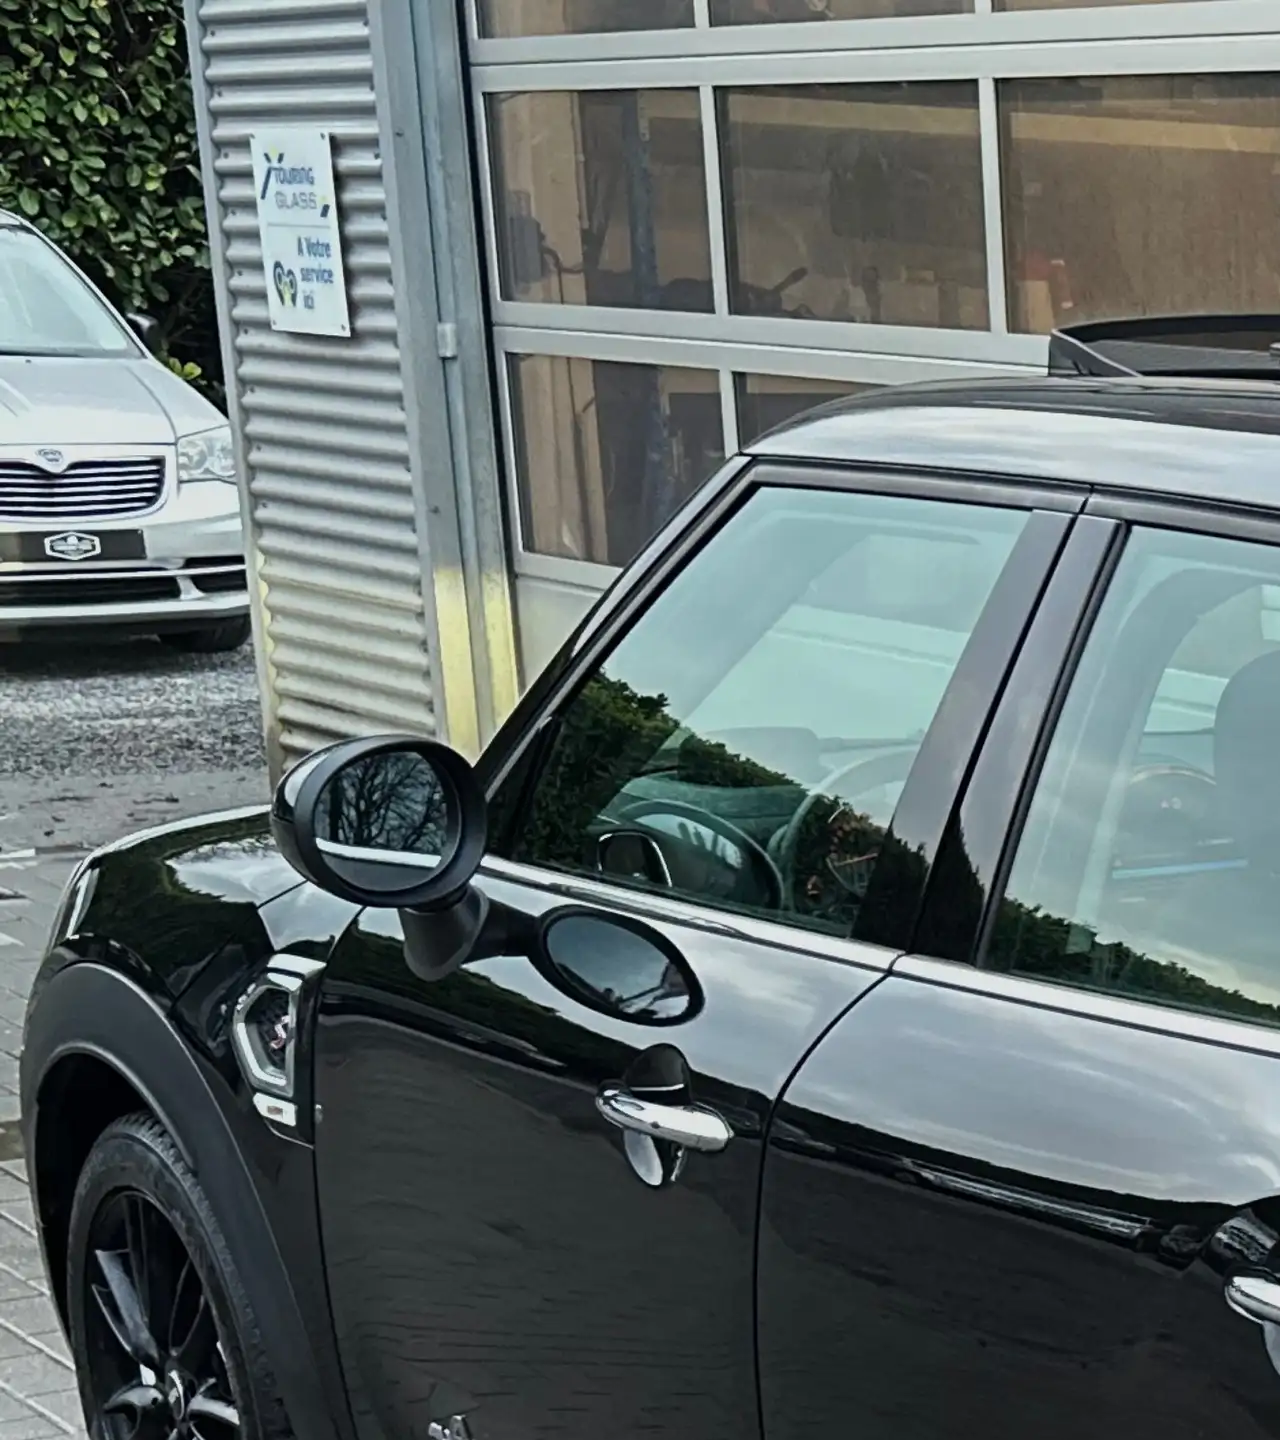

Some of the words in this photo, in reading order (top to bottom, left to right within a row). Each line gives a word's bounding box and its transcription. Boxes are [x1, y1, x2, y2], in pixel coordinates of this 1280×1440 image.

[270, 166, 316, 186] TOURING
[274, 191, 318, 211] GLASS
[304, 236, 332, 259] Votre
[300, 265, 334, 284] service
[302, 290, 316, 311] ici
